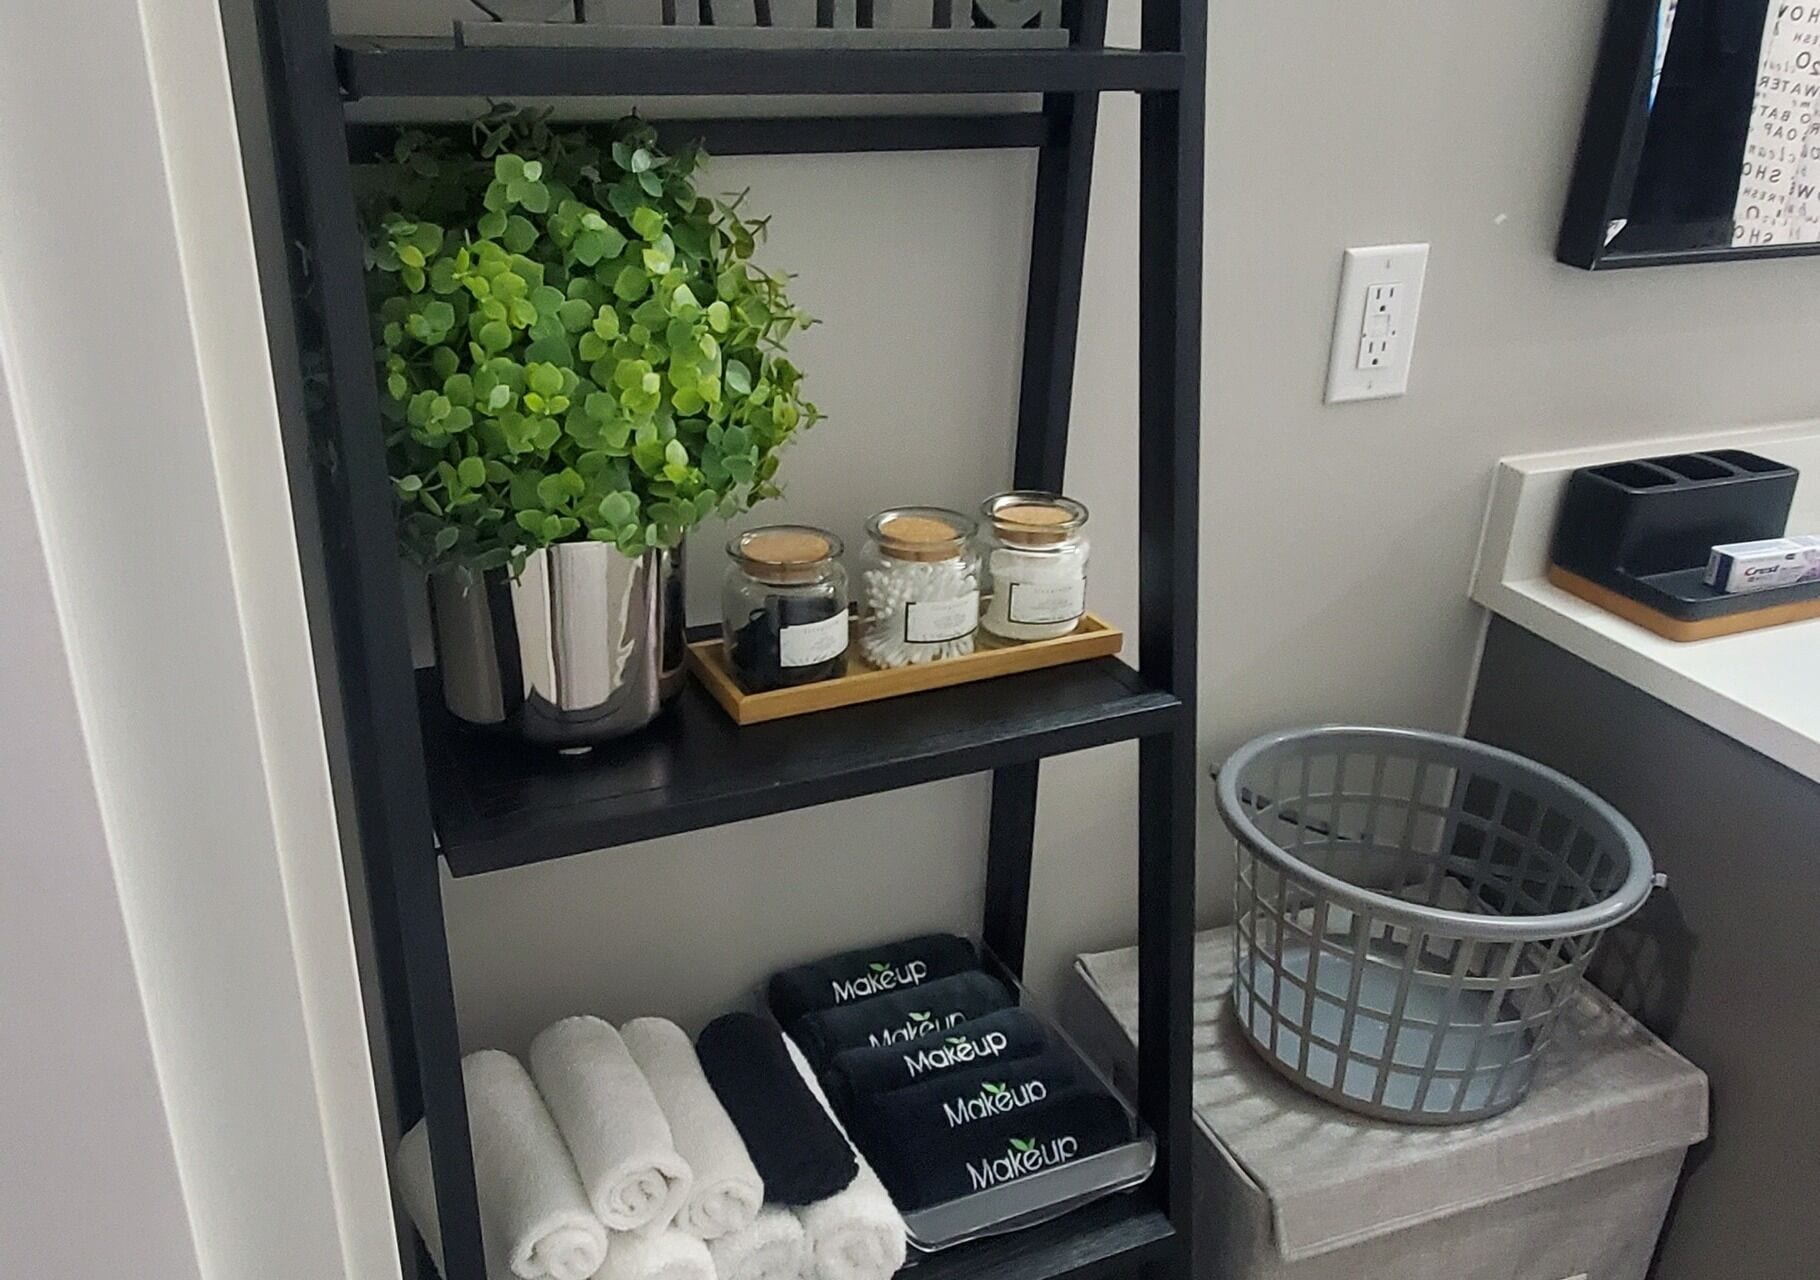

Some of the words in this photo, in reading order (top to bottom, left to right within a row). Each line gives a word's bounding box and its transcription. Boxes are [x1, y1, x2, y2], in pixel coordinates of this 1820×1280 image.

[1744, 564, 1780, 577] Crest
[831, 959, 928, 1004] Makeup
[903, 1031, 1007, 1077] Makeup
[943, 1081, 1047, 1128] Makeup
[965, 1136, 1078, 1190] Makeup
